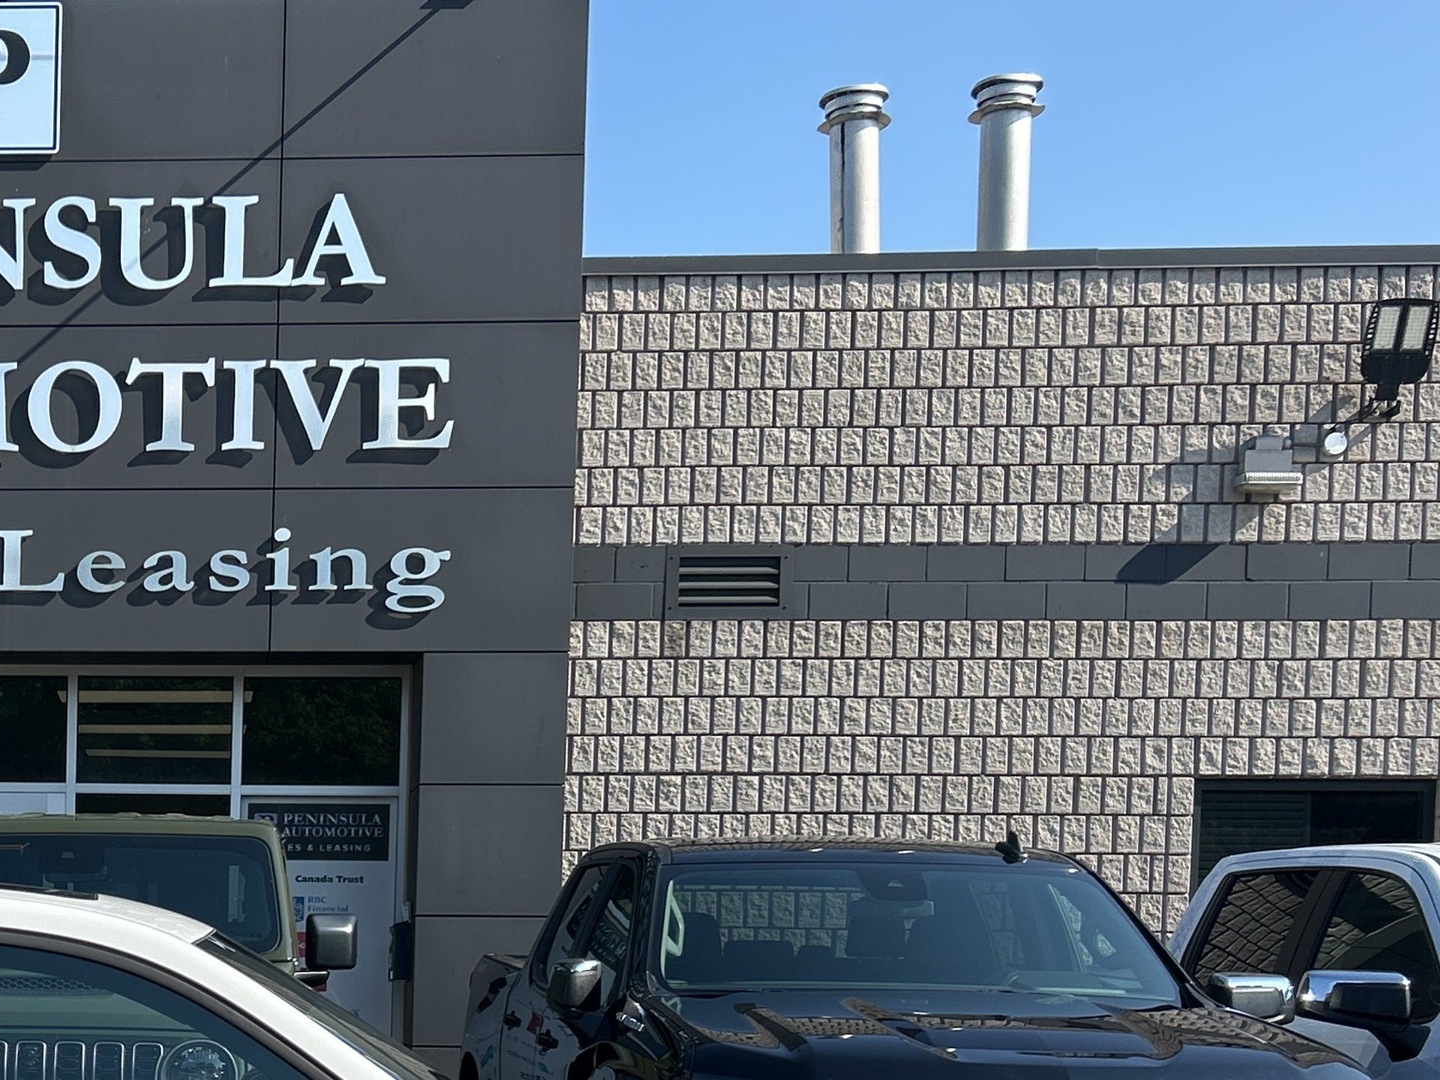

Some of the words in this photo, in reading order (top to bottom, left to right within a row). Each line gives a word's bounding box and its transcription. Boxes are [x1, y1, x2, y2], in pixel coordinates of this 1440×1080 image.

[283, 813, 383, 826] PENINSULA
[282, 826, 384, 838] AUTOMOTIVE
[319, 843, 372, 852] LEASING
[295, 874, 334, 884] Canada
[336, 874, 364, 884] Trust
[307, 896, 327, 904] RBC
[307, 904, 349, 912] Financial
